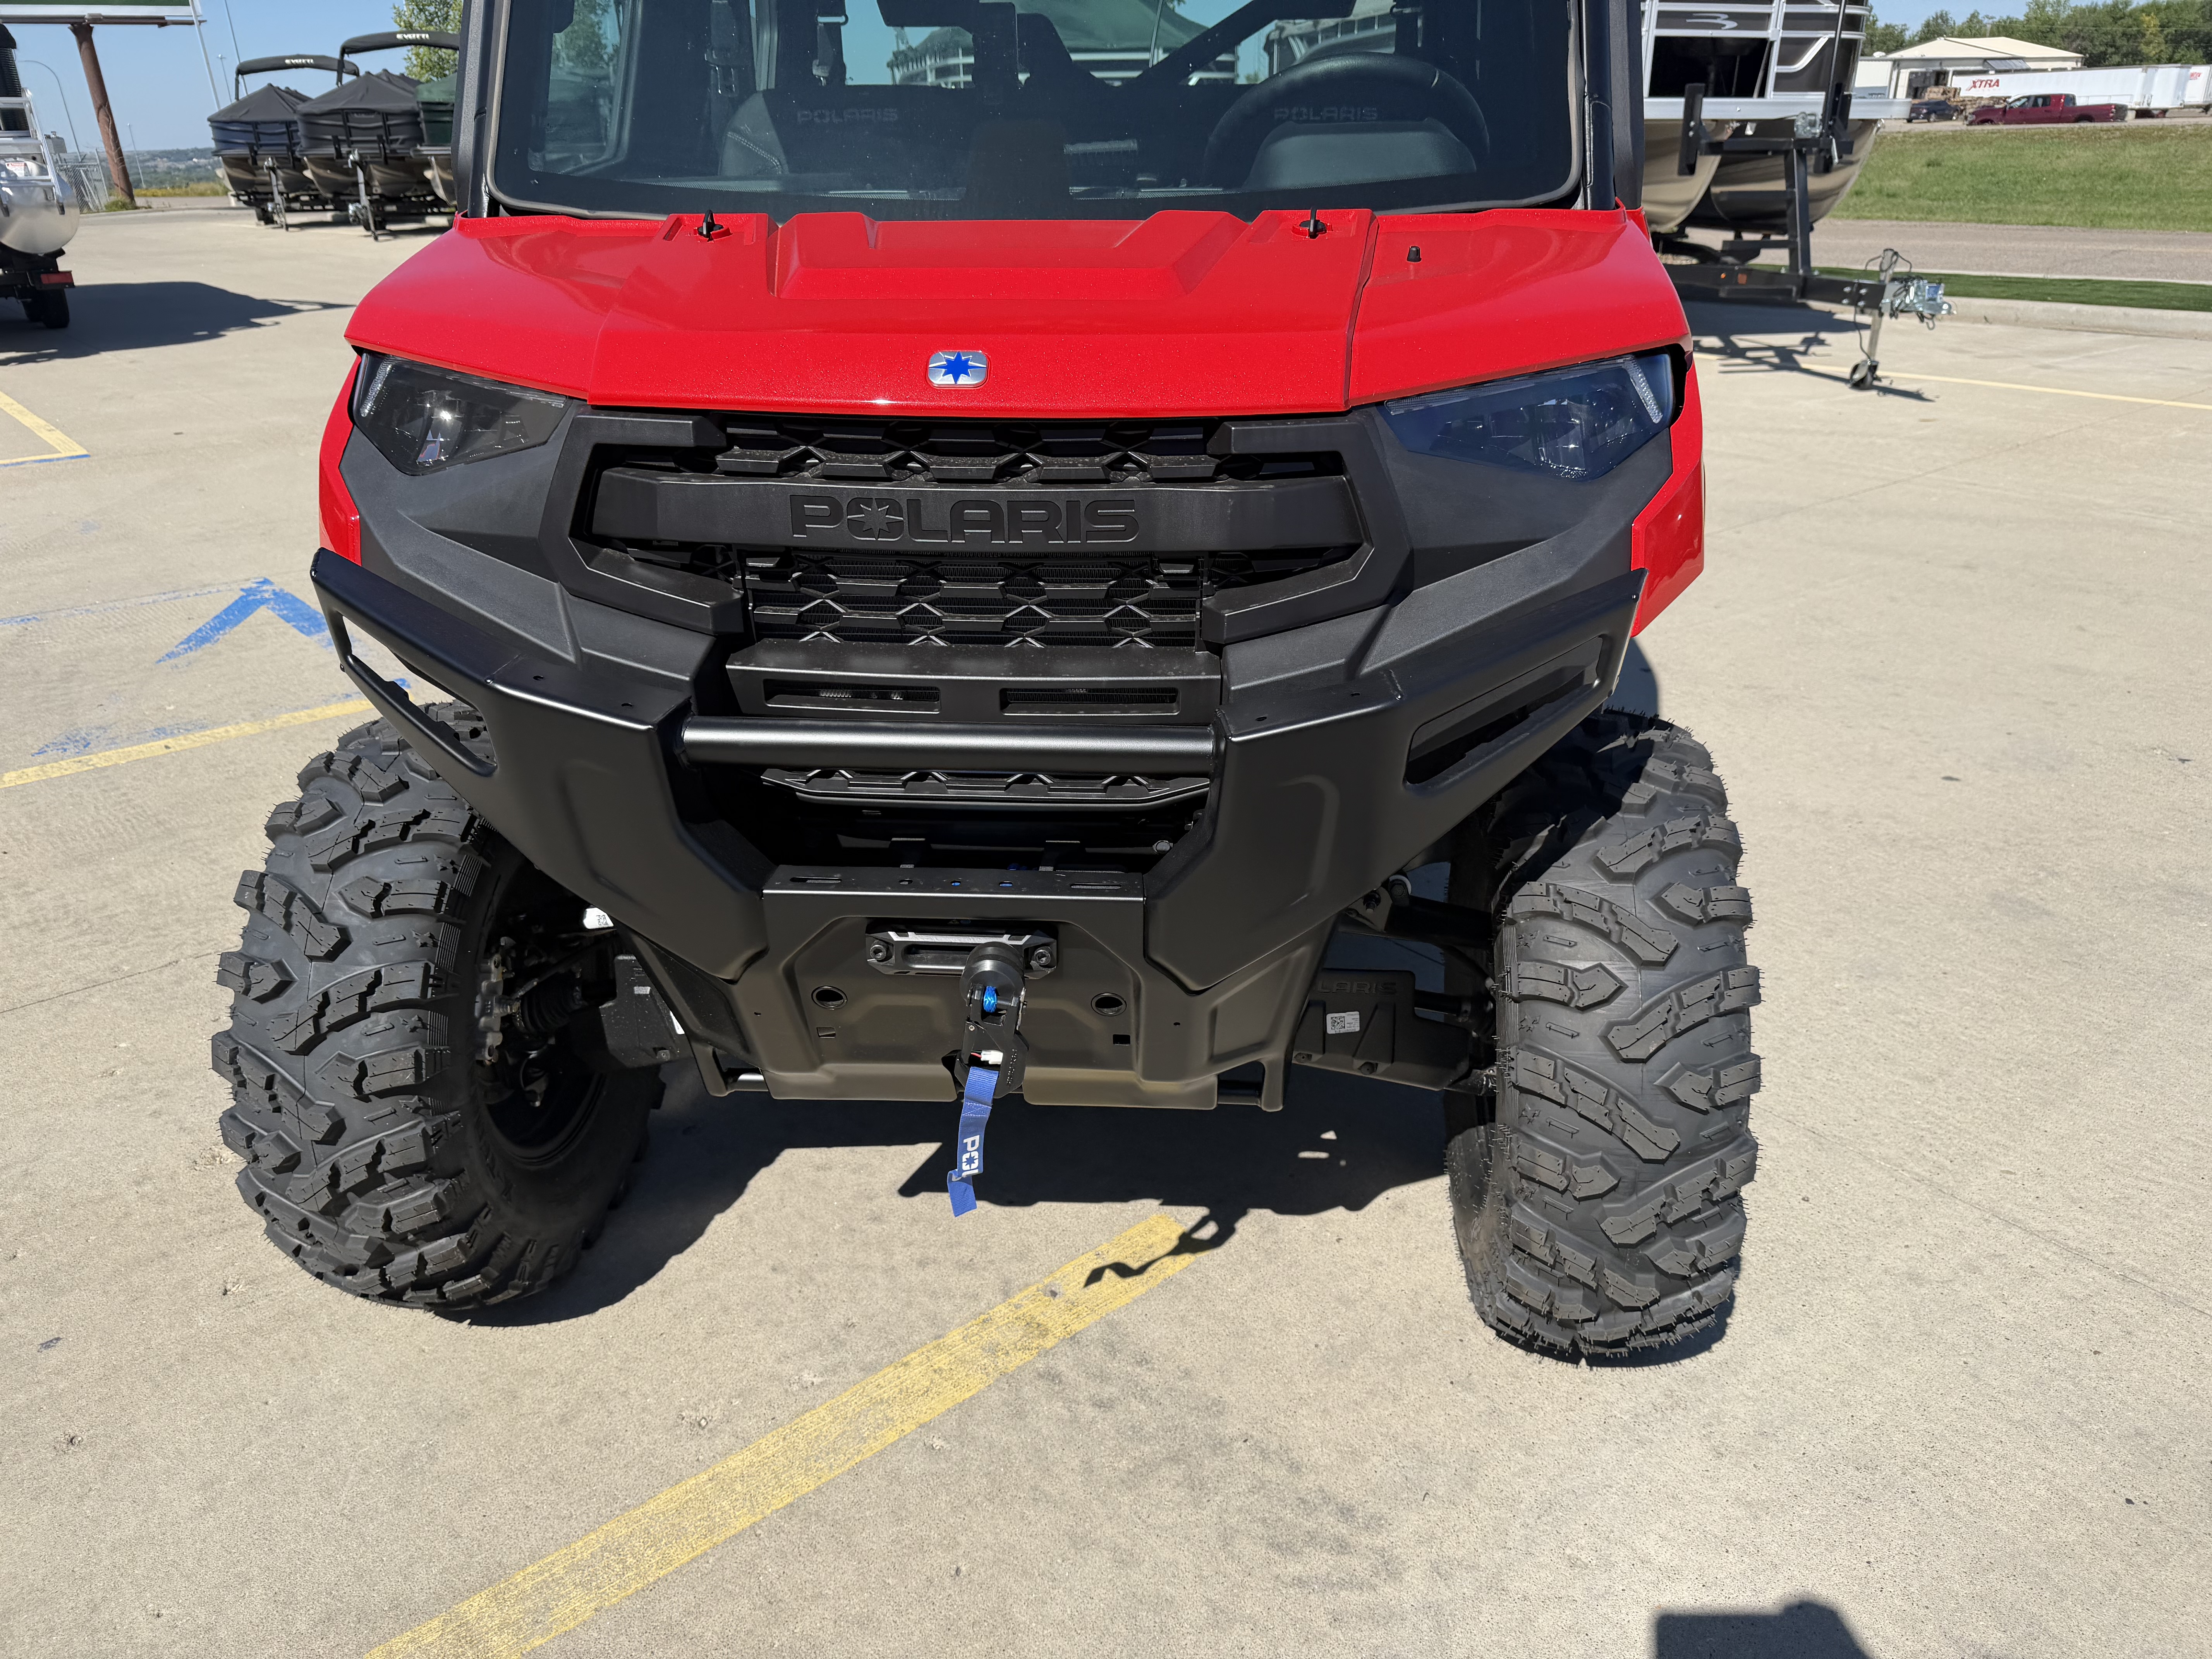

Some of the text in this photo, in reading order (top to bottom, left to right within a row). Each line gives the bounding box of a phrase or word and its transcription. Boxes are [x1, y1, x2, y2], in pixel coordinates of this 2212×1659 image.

[1966, 78, 2000, 91] XTRA
[797, 108, 899, 124] POLARIS
[1273, 106, 1378, 121] POLARIS
[790, 495, 1139, 543] POLARIS
